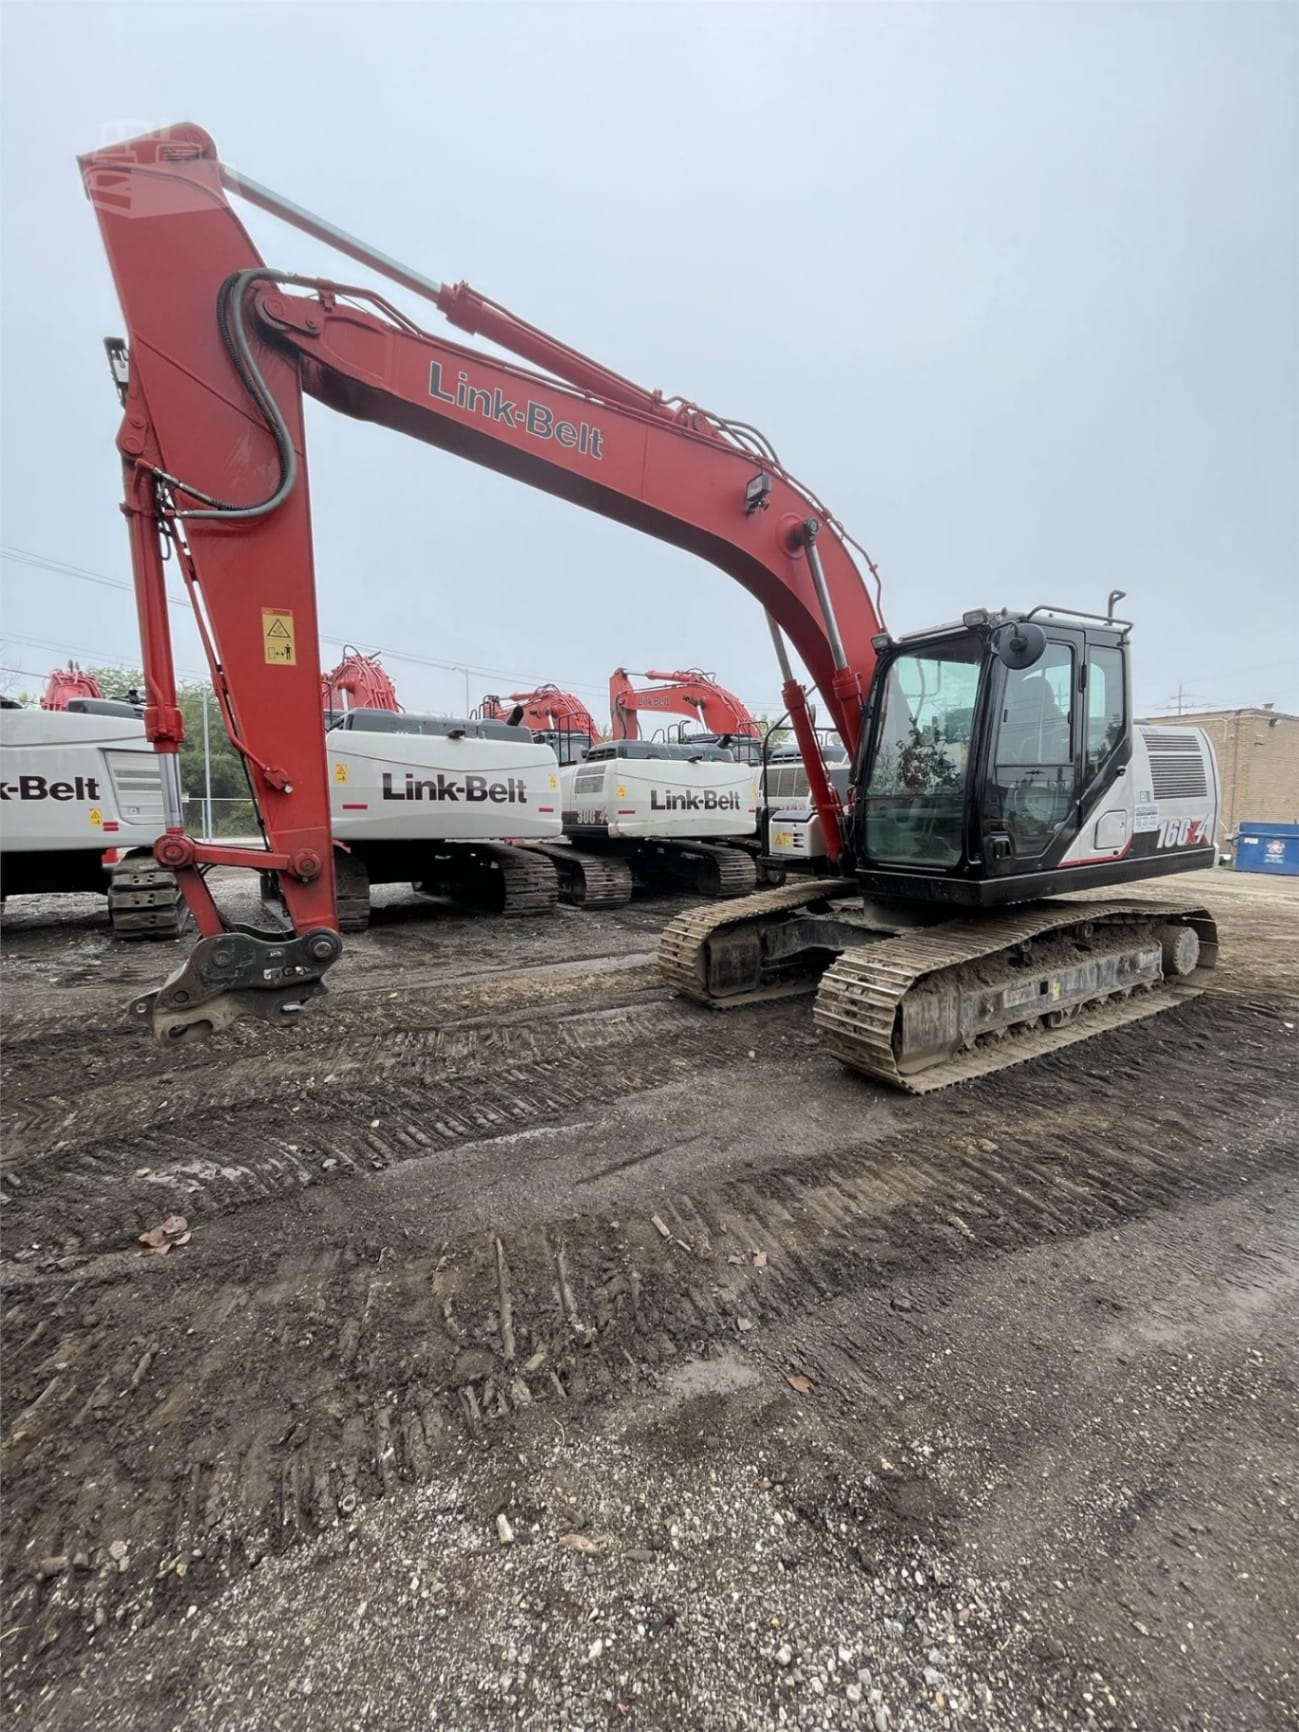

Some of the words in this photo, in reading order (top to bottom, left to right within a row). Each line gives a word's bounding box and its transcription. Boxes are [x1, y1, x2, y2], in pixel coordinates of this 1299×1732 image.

[428, 360, 605, 461] Link-Belt
[382, 772, 527, 803] Link-Belt
[650, 789, 741, 812] Link-Belt
